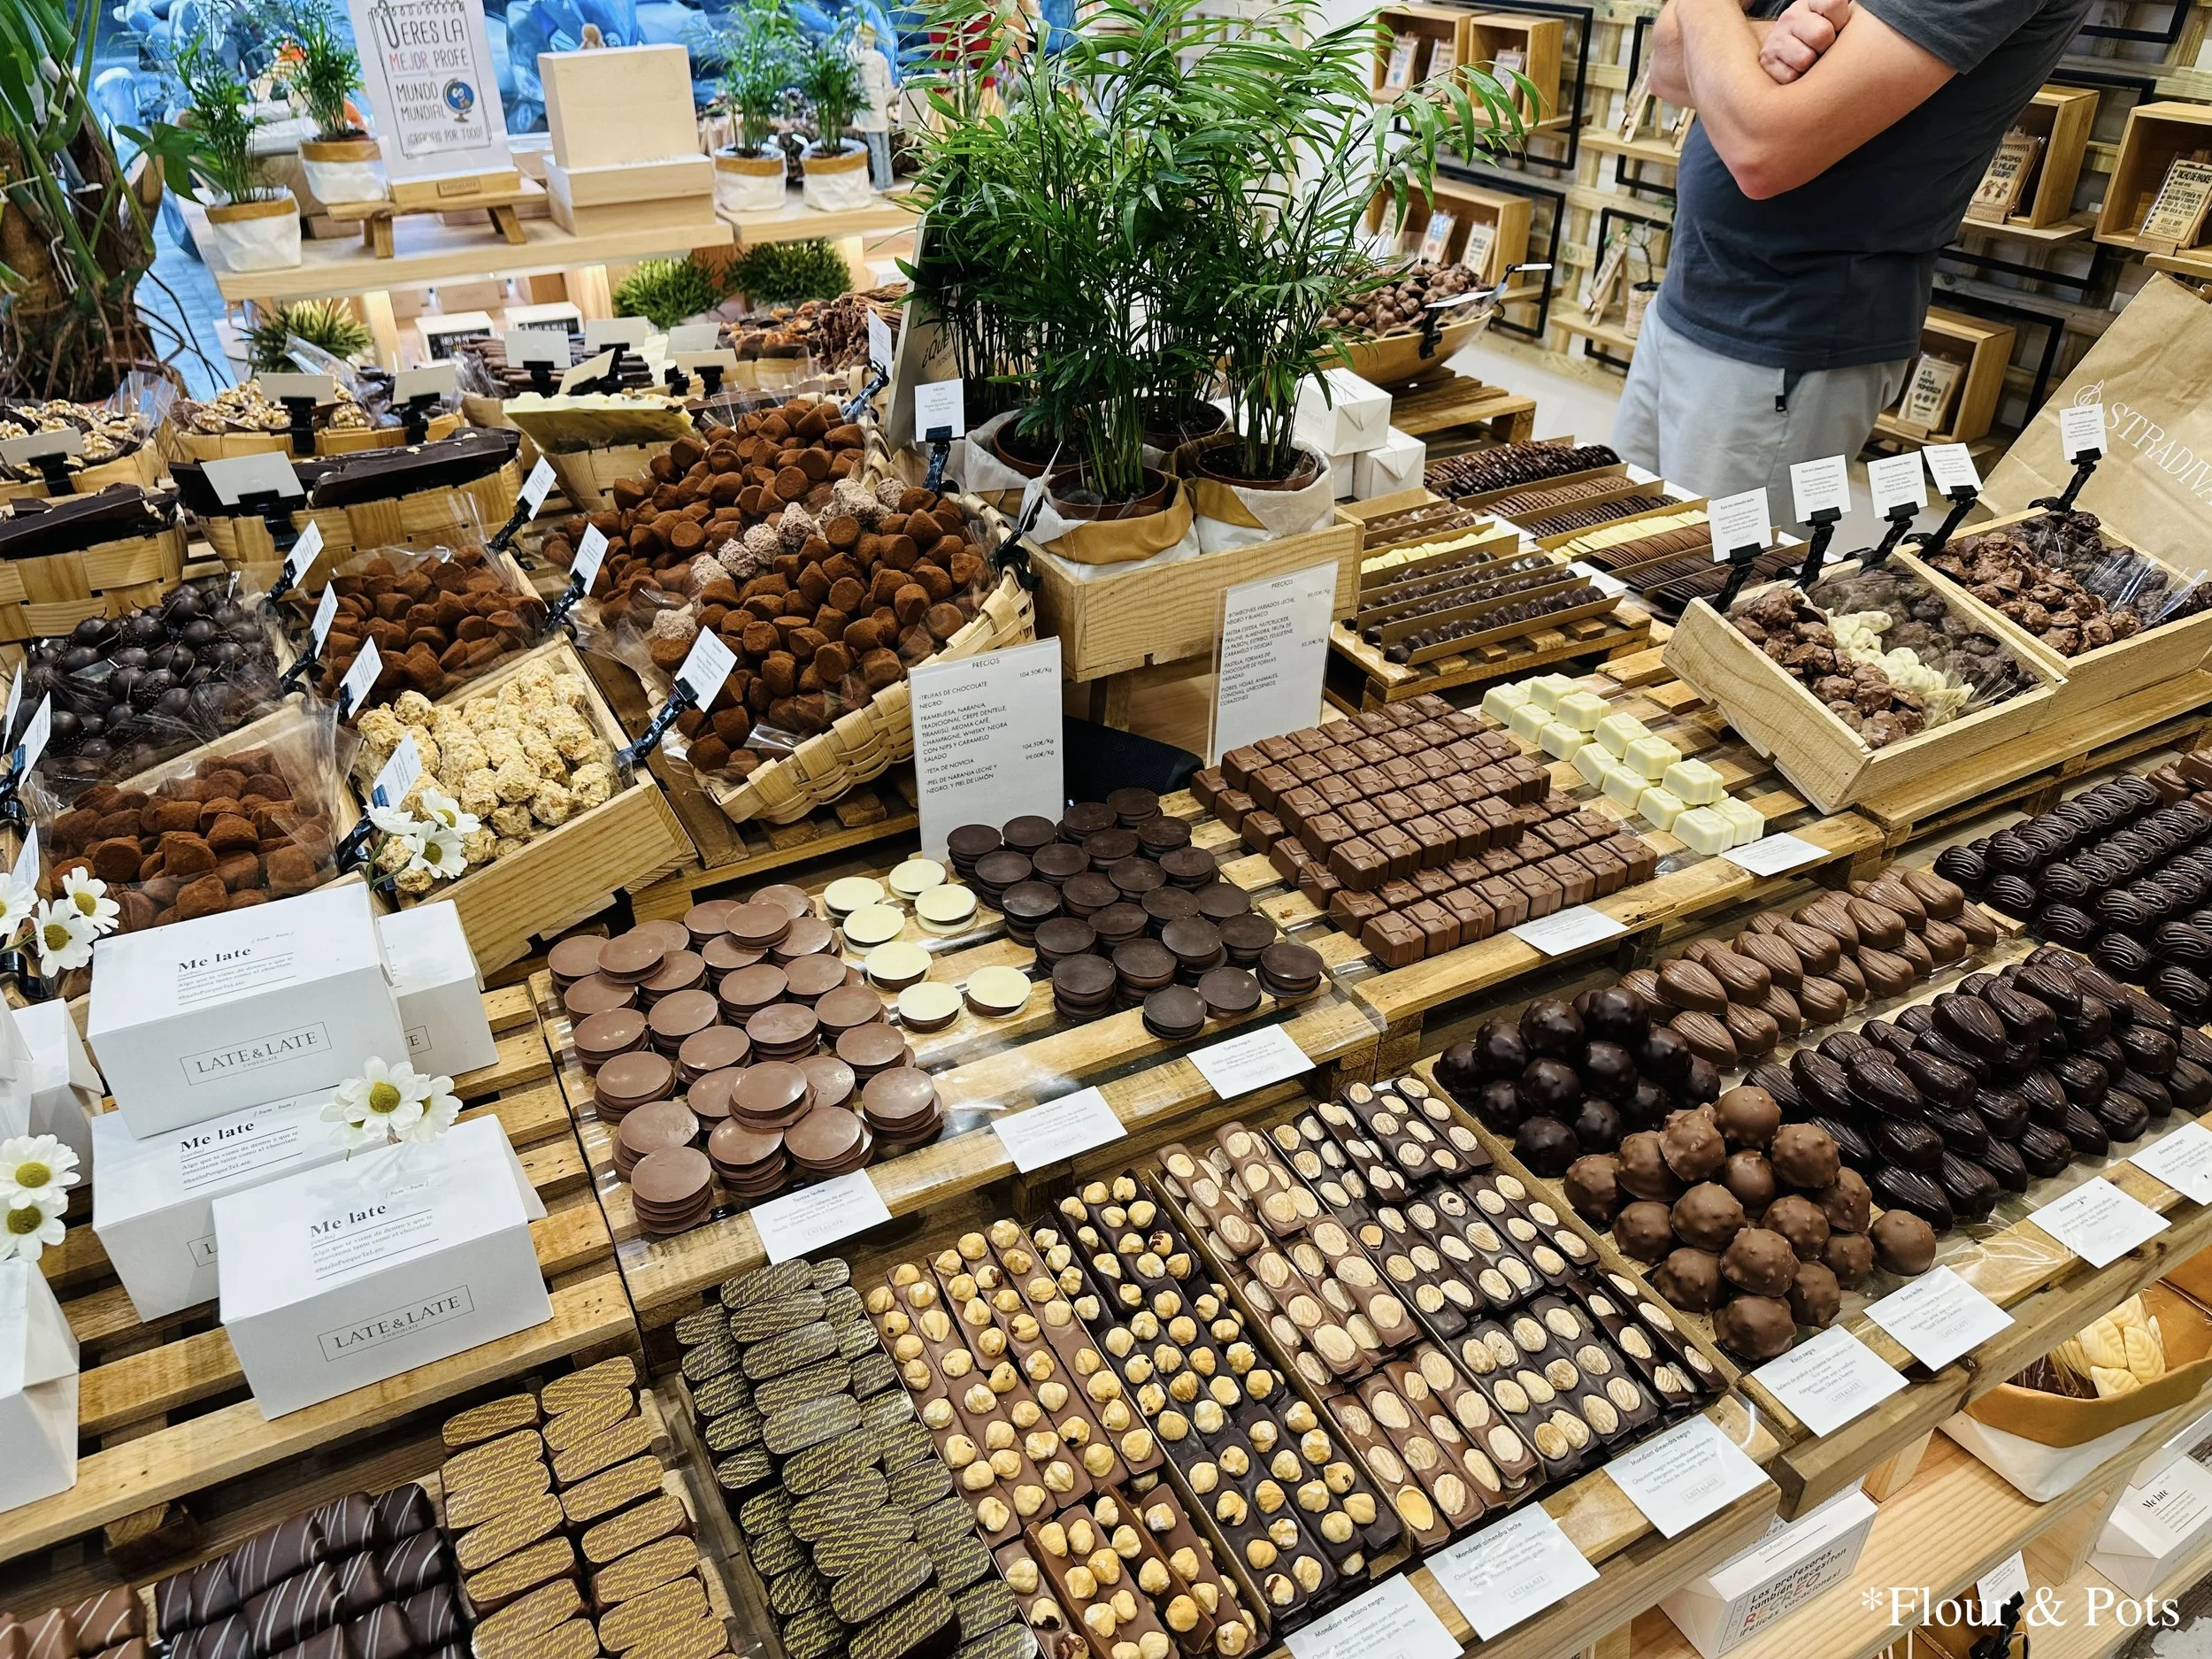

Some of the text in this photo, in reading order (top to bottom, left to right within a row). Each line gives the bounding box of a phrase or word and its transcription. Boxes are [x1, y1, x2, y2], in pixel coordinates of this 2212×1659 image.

[401, 18, 464, 45] ERES LA
[389, 48, 469, 71] MEJOR PROFE
[396, 81, 438, 102] MUNDO
[401, 104, 446, 122] MUNDIAL
[445, 129, 458, 141] POR
[2000, 154, 2022, 163] HACEMOS
[1992, 170, 2011, 179] EQUIPO
[1999, 163, 2017, 171] MEJOR
[2103, 403, 2212, 506] STRADIV
[1271, 579, 1293, 588] PRECIOS
[1257, 601, 1279, 610] VARIADOS
[1224, 647, 1248, 657] CARAMELO
[1244, 653, 1263, 662] FORMAS
[972, 657, 999, 668] PRECIOS
[1222, 664, 1250, 675] CHOCOLATE
[1257, 657, 1276, 665] FORMAS
[952, 680, 987, 693] CHOCOLATE
[962, 712, 978, 720] CREPE
[951, 721, 973, 731] AROMA
[988, 722, 1007, 730] NEGRA
[958, 734, 989, 746] CARAMELO
[923, 752, 947, 762] SALADO
[949, 758, 973, 768] NOVICIA
[948, 769, 974, 780] NARANJA
[975, 765, 992, 773] LECHE
[974, 772, 993, 782] LIMÓN
[178, 946, 251, 971] Me late
[180, 1120, 254, 1151] Me late
[182, 1161, 198, 1170] Algo
[251, 1138, 270, 1148] dentro
[182, 1161, 218, 1175] entusiasma
[310, 1202, 386, 1236] Me late
[312, 1248, 329, 1257] Algo
[353, 1233, 372, 1243] viene
[383, 1223, 404, 1233] dentro
[313, 1248, 350, 1263] entusiasma
[353, 1241, 370, 1250] tanto
[372, 1235, 389, 1244] como
[382, 1324, 418, 1338] CHOCOLATE
[1629, 1430, 1693, 1465] Mandiant almendra negro
[2142, 1489, 2169, 1508] Me late
[1454, 1521, 1523, 1559] Mandiant almendra leche
[1748, 1548, 1847, 1613] también necesitan
[1750, 1548, 1833, 1603] Los profesores
[1783, 1569, 1840, 1608] vacaciones!
[1743, 1572, 1821, 1625] RECREO
[1313, 1595, 1386, 1637] Mandiant avellana negro
